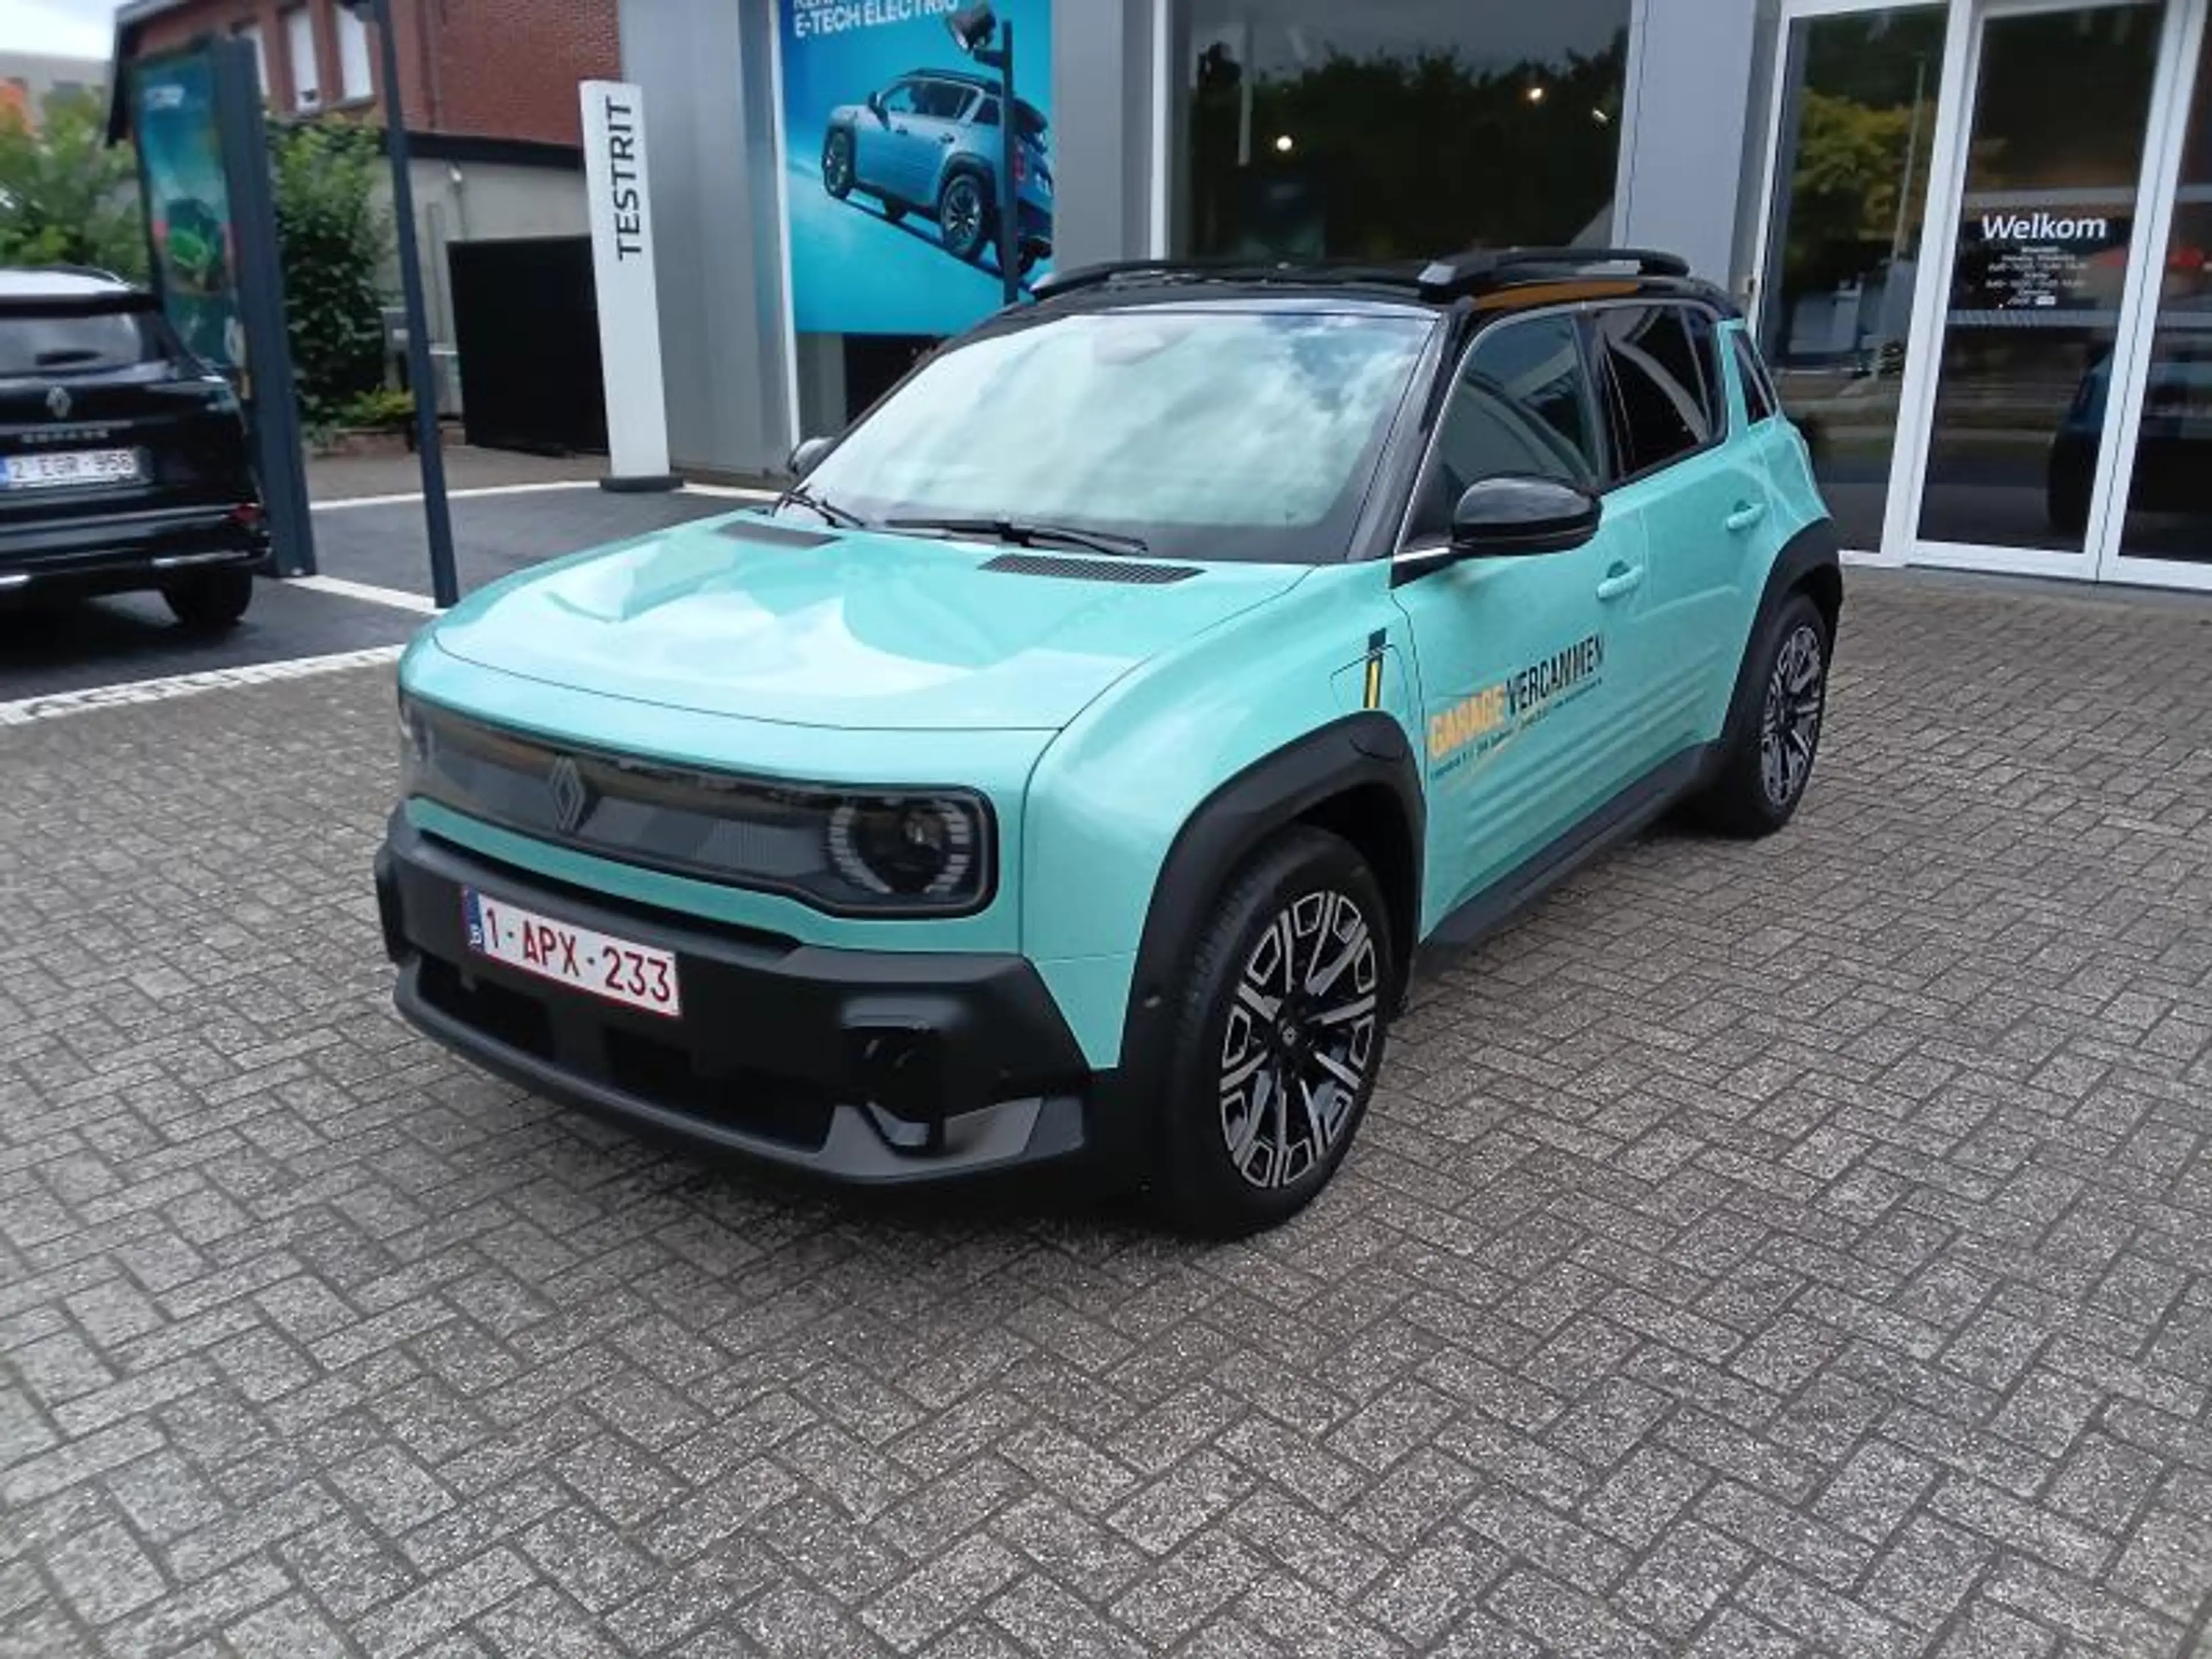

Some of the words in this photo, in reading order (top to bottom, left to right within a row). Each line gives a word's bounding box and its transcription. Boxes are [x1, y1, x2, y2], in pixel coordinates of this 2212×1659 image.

[795, 3, 861, 38] E-TECH
[606, 94, 642, 262] TESTRIT
[1982, 213, 2106, 240] Welkom
[1430, 686, 1504, 759] GARAGE
[1506, 633, 1604, 715] VERCAMMEN
[487, 908, 671, 1002] 1-APX-233
